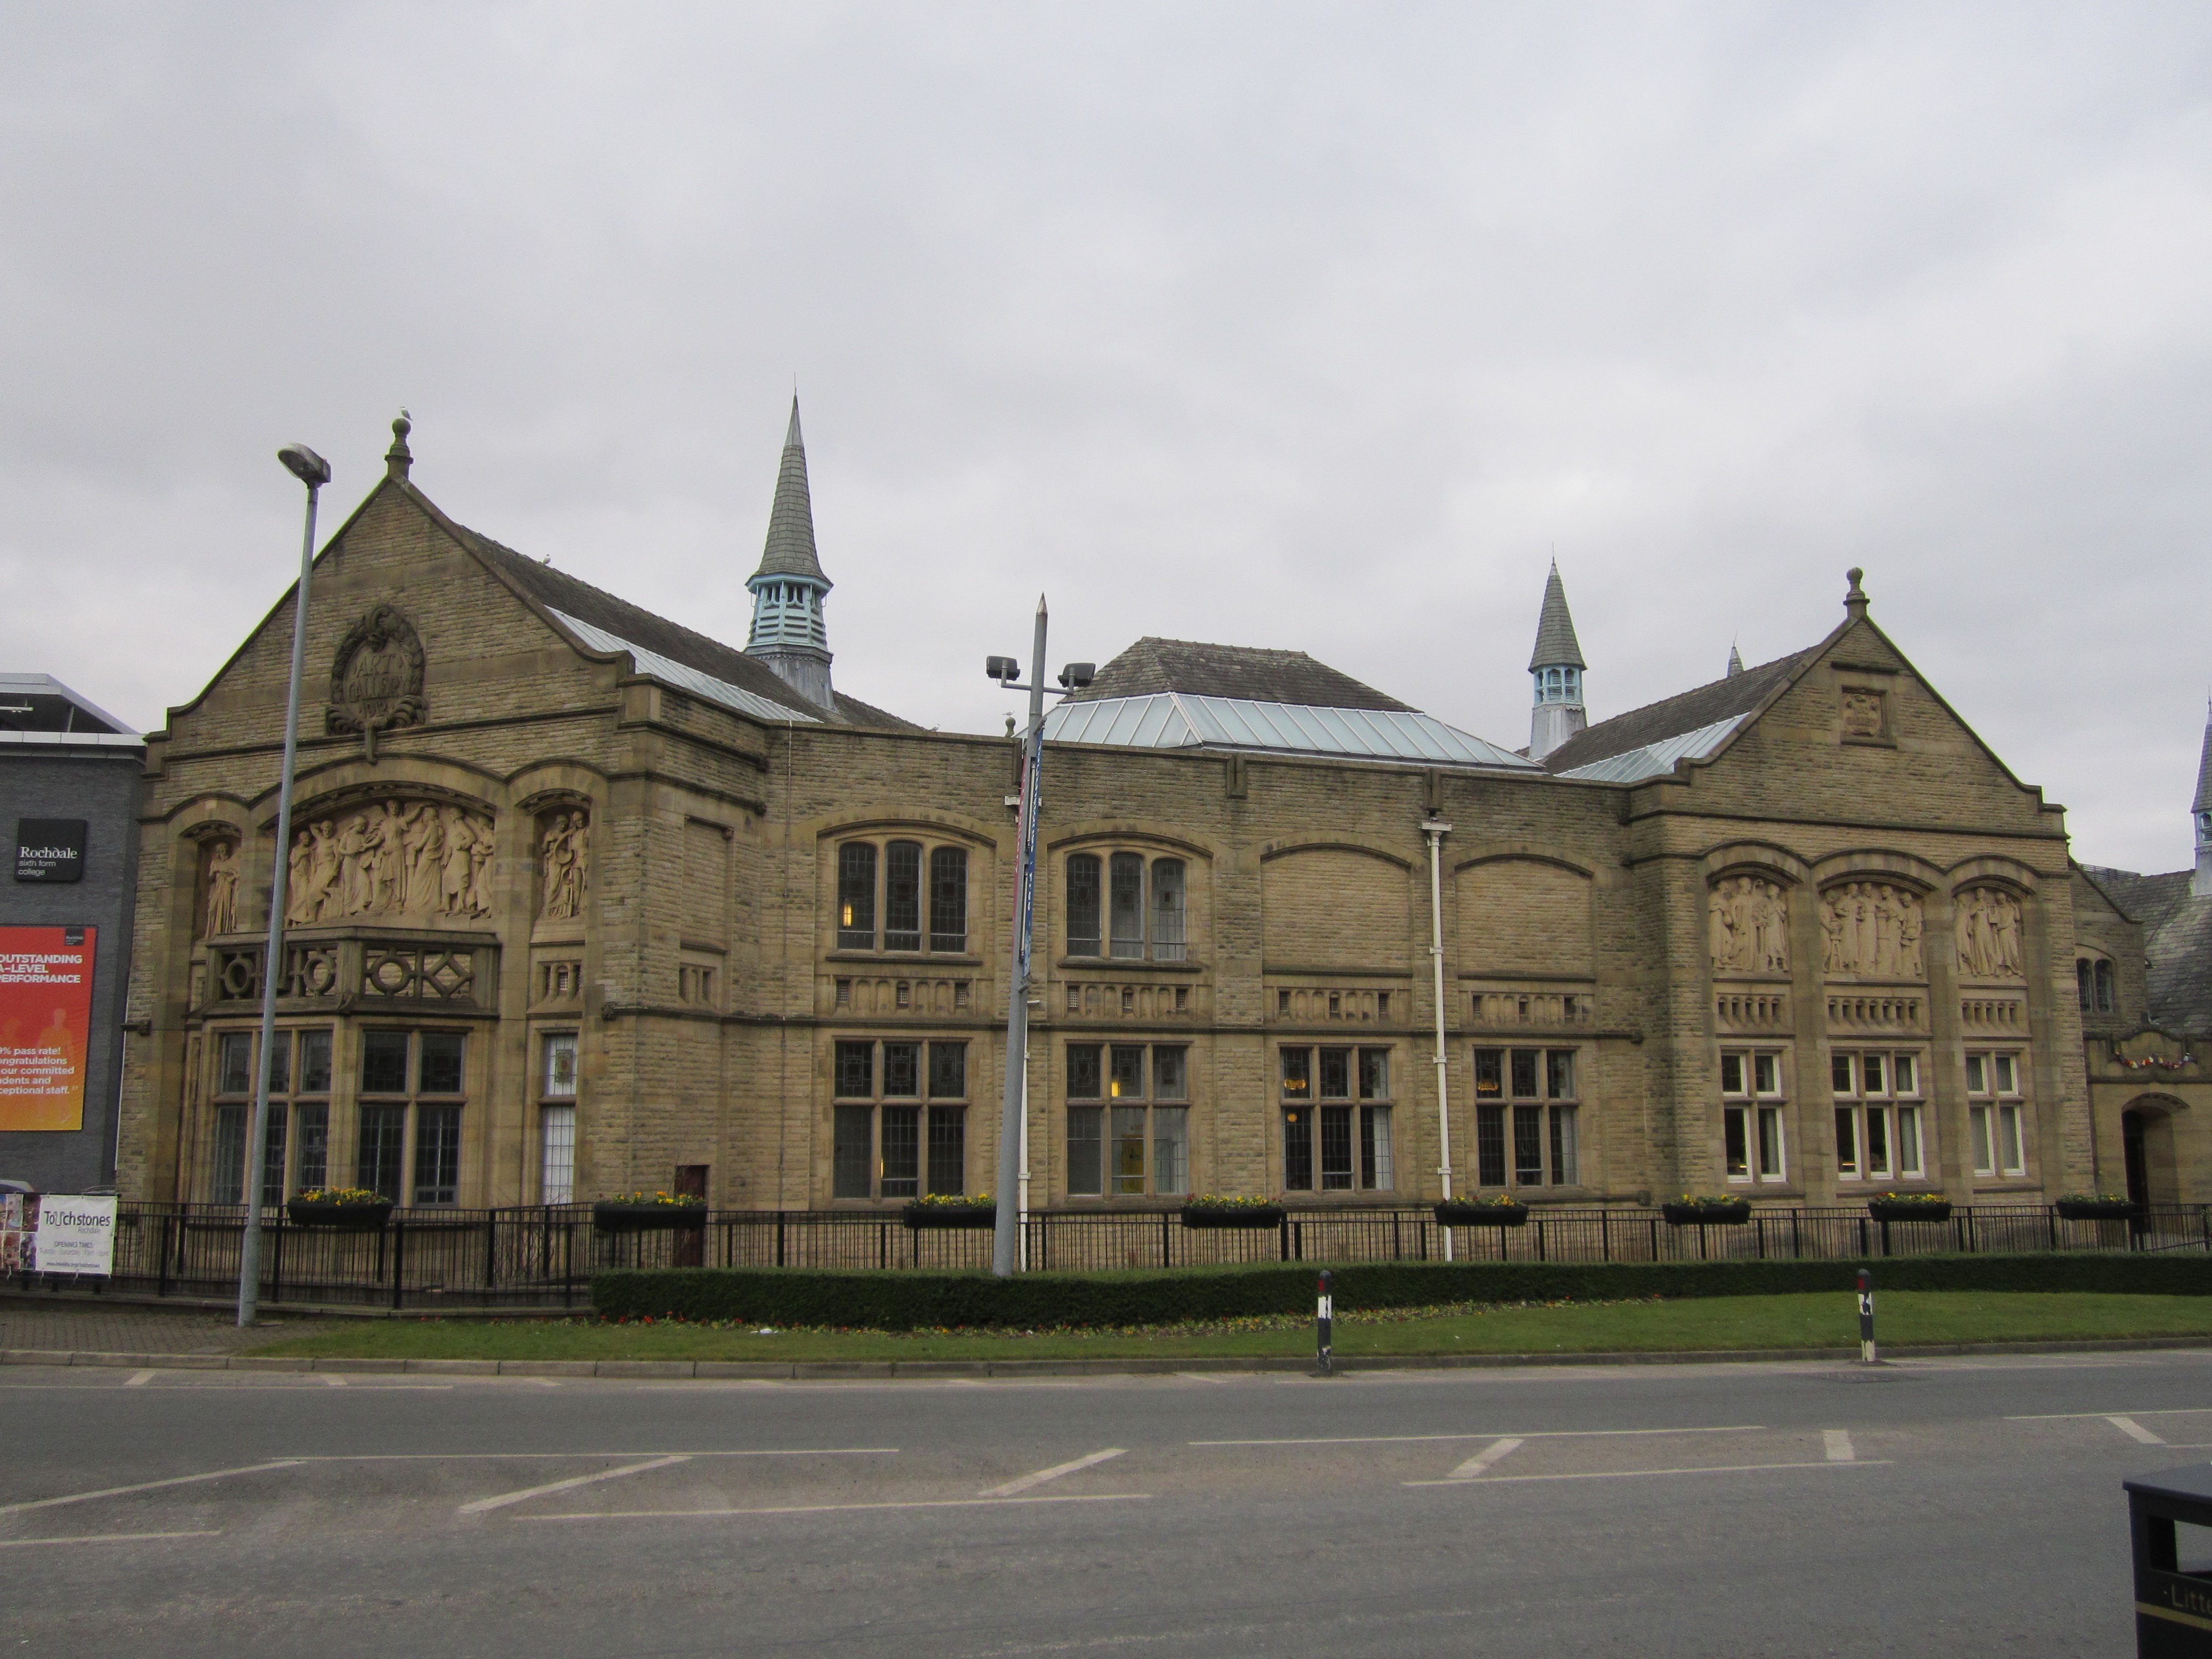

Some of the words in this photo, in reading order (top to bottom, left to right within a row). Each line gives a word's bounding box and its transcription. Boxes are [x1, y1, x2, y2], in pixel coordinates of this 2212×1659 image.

[356, 655, 396, 678] ART
[20, 846, 78, 859] Rochdale
[18, 868, 46, 877] college
[0, 954, 83, 964] OUTSTANDING
[44, 1210, 111, 1227] Touchstones
